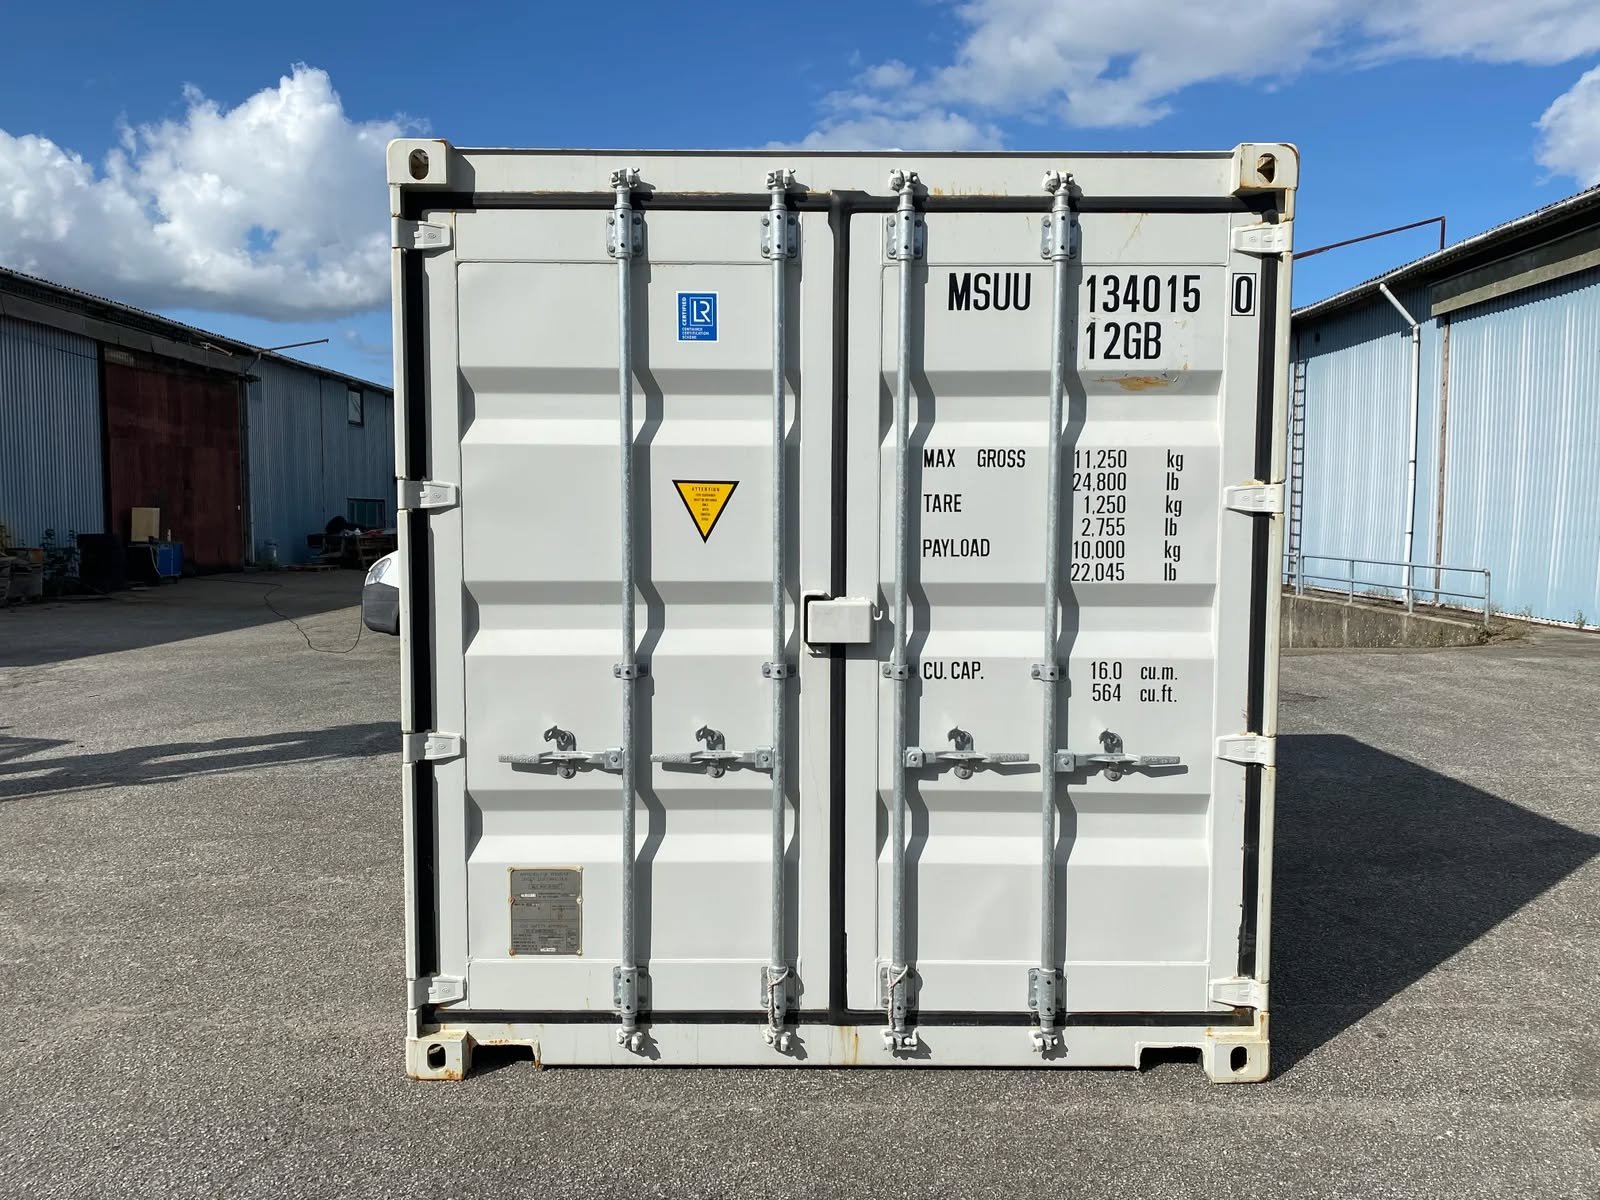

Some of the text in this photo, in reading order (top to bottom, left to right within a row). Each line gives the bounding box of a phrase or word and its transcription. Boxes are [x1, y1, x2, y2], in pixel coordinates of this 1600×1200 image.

[948, 272, 1253, 313] MSUU 134015 0
[694, 301, 710, 322] LR
[1085, 322, 1162, 360] 12GB
[924, 449, 1184, 471] MAX GROSS 11,250 kg
[1073, 472, 1179, 492] 24,800 lb
[924, 494, 1182, 517] TARE 1,250 kg
[1082, 518, 1177, 537] 2,755 lb
[923, 539, 1181, 562] PAYLOAD 10,000 kg
[1071, 563, 1176, 582] 22,045 lb
[1091, 662, 1122, 680] 16.0
[1141, 667, 1178, 681] cu.m.
[1092, 684, 1177, 702] 564 cu.ft.
